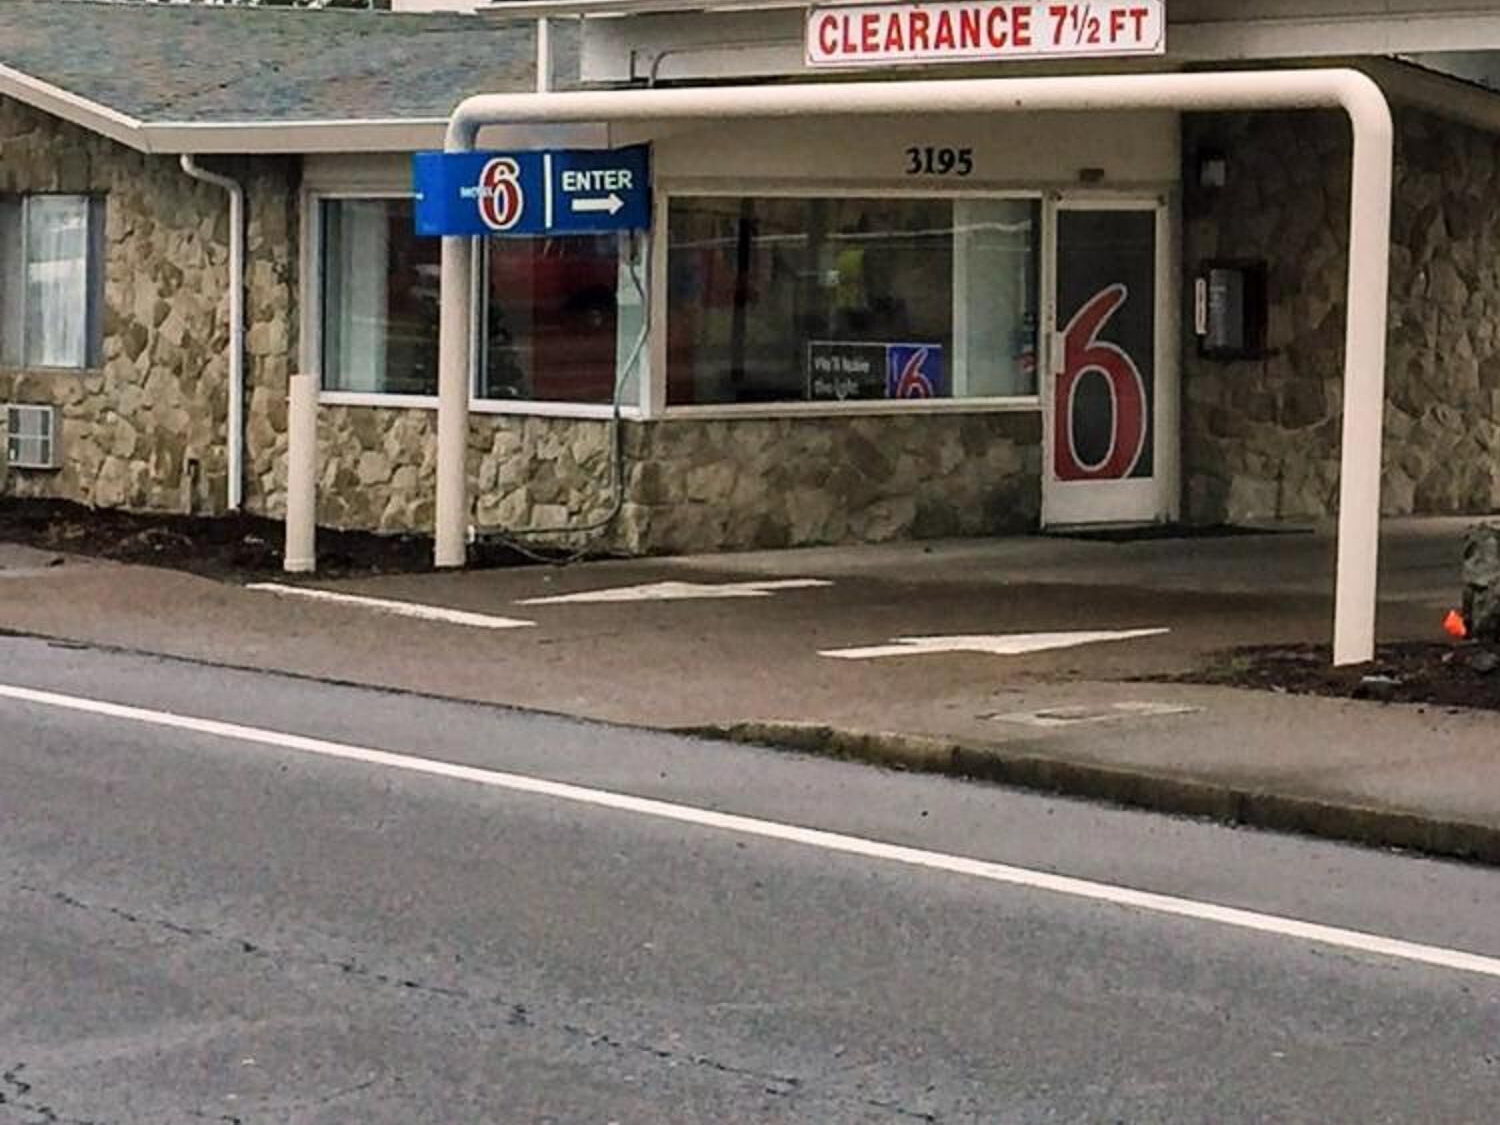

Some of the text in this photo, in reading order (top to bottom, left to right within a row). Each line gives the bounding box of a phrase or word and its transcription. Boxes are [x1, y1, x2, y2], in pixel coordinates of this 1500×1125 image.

[817, 5, 1032, 55] CLEARANCE
[1108, 8, 1149, 43] FT
[561, 170, 634, 192] ENTER
[905, 147, 974, 175] 3195
[478, 157, 524, 230] 6
[1054, 282, 1148, 481] 6
